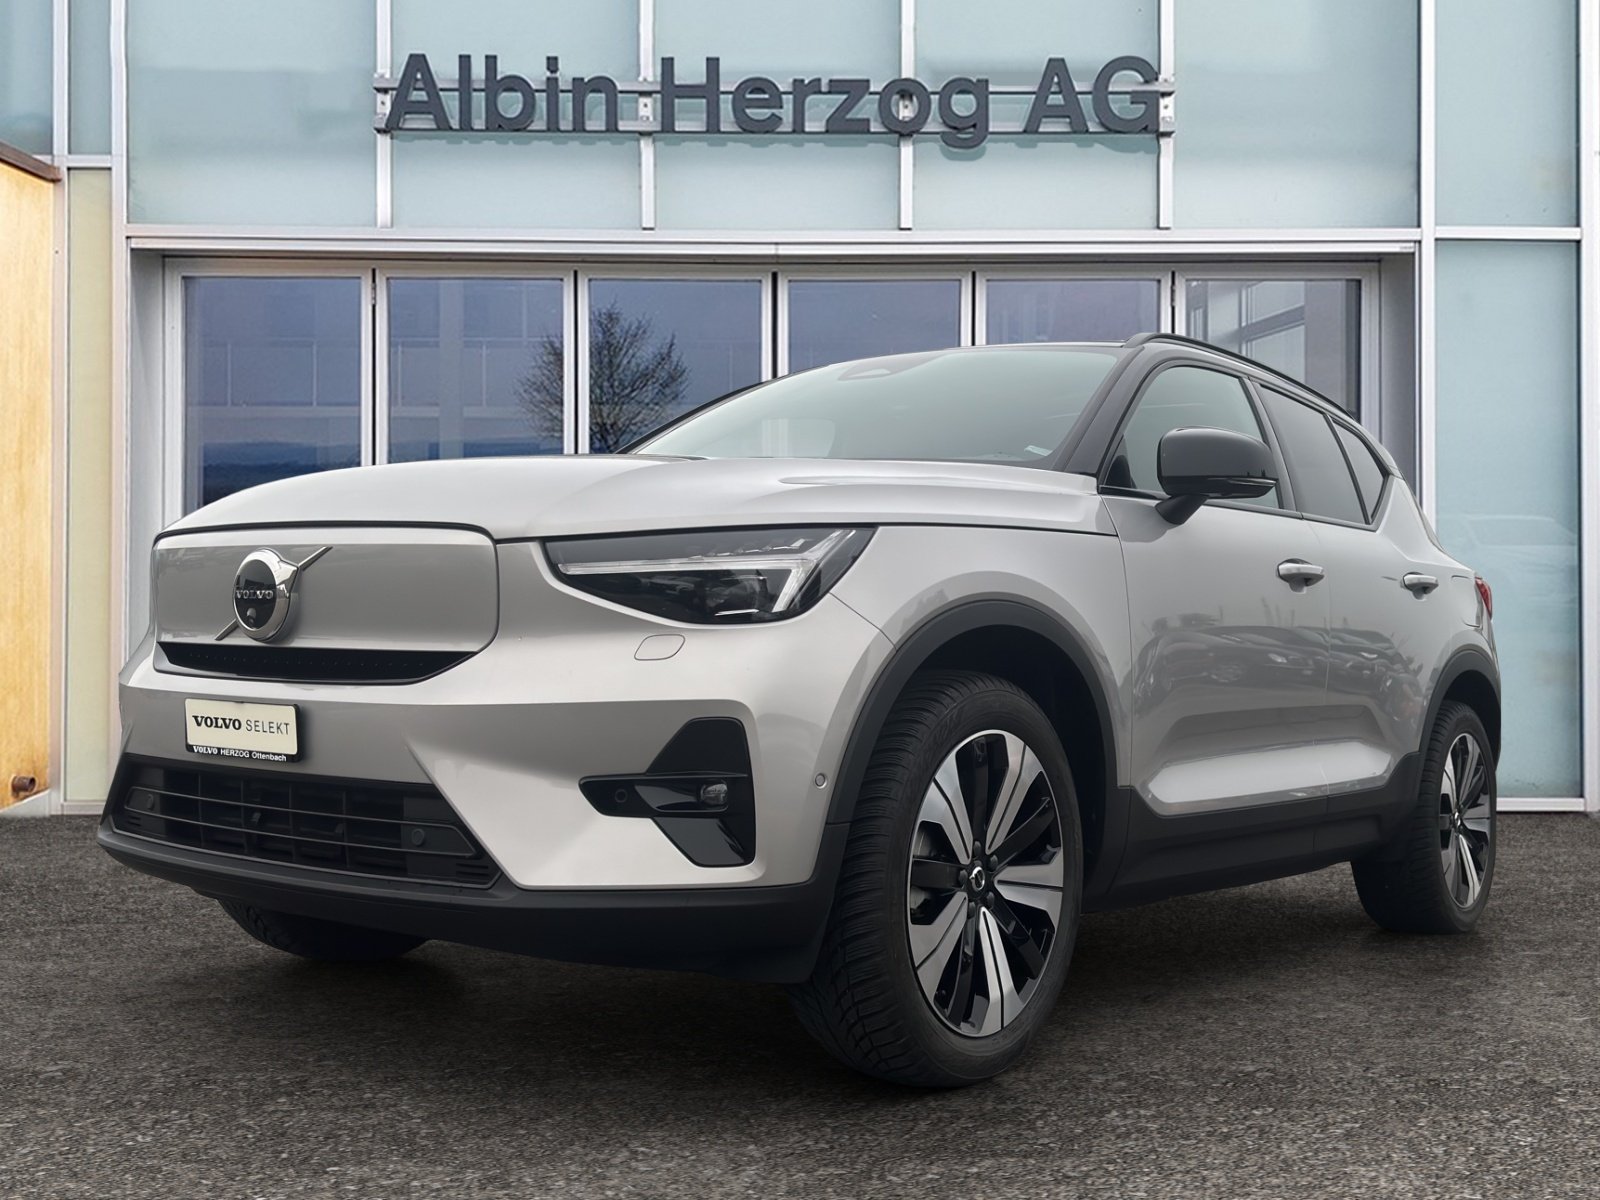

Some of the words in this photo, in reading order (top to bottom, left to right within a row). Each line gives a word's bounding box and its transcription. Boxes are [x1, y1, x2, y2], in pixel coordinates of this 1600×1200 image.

[386, 53, 619, 132] Albin
[661, 56, 989, 149] Herzog
[1023, 55, 1161, 133] AG
[236, 590, 274, 599] VOLVO
[192, 715, 242, 731] VOLVO
[245, 719, 290, 735] SELEKT
[193, 745, 218, 755] VOLVO
[220, 748, 250, 758] HERZOG
[251, 751, 287, 762] Ottenbach
